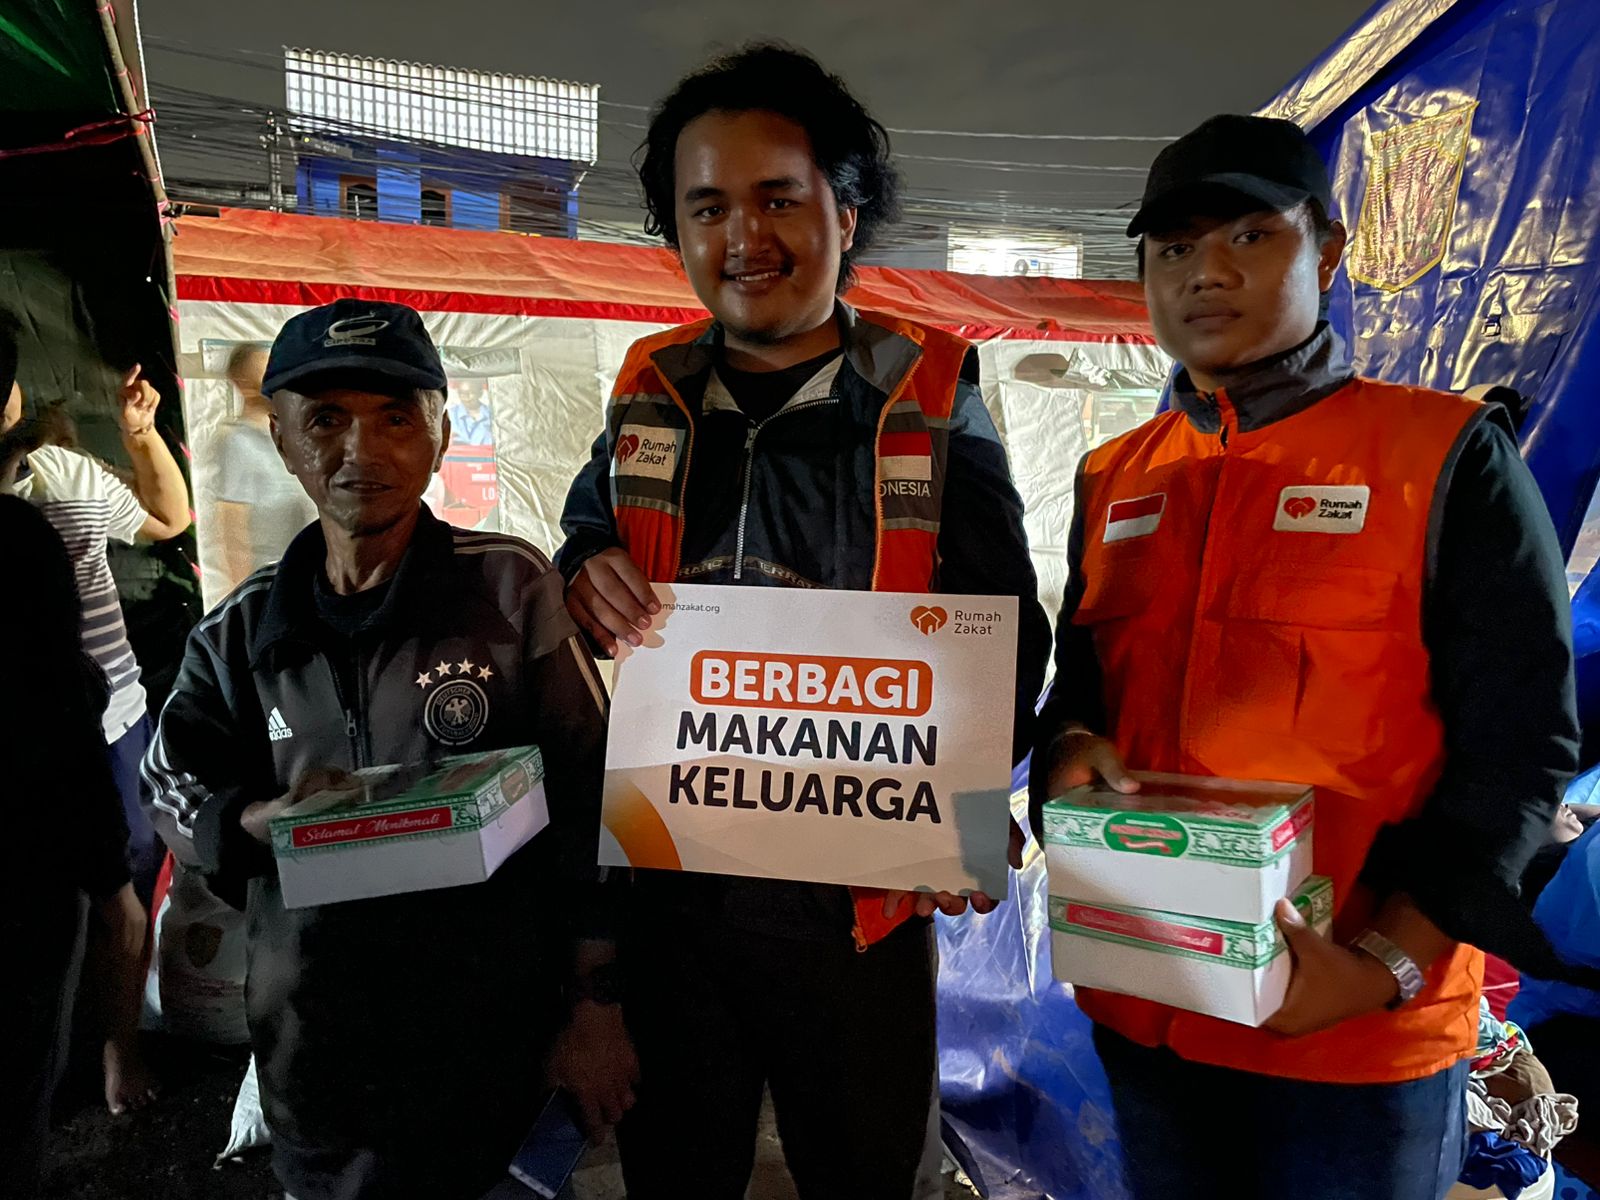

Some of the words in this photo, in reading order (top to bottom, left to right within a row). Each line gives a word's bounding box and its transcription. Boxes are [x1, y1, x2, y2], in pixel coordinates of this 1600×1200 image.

[640, 438, 677, 453] Rumah
[636, 452, 667, 466] Zakat
[1320, 498, 1363, 509] Rumah
[1318, 508, 1353, 519] Zakat
[661, 602, 721, 614] mahzakat.org
[954, 610, 1002, 622] Rumah
[954, 622, 993, 635] Zakat
[701, 657, 920, 710] BERBAGI
[676, 710, 938, 766] MAKANAN
[668, 764, 942, 824] KELUARGA
[302, 823, 360, 842] Selamat
[366, 812, 441, 833] Menikmati
